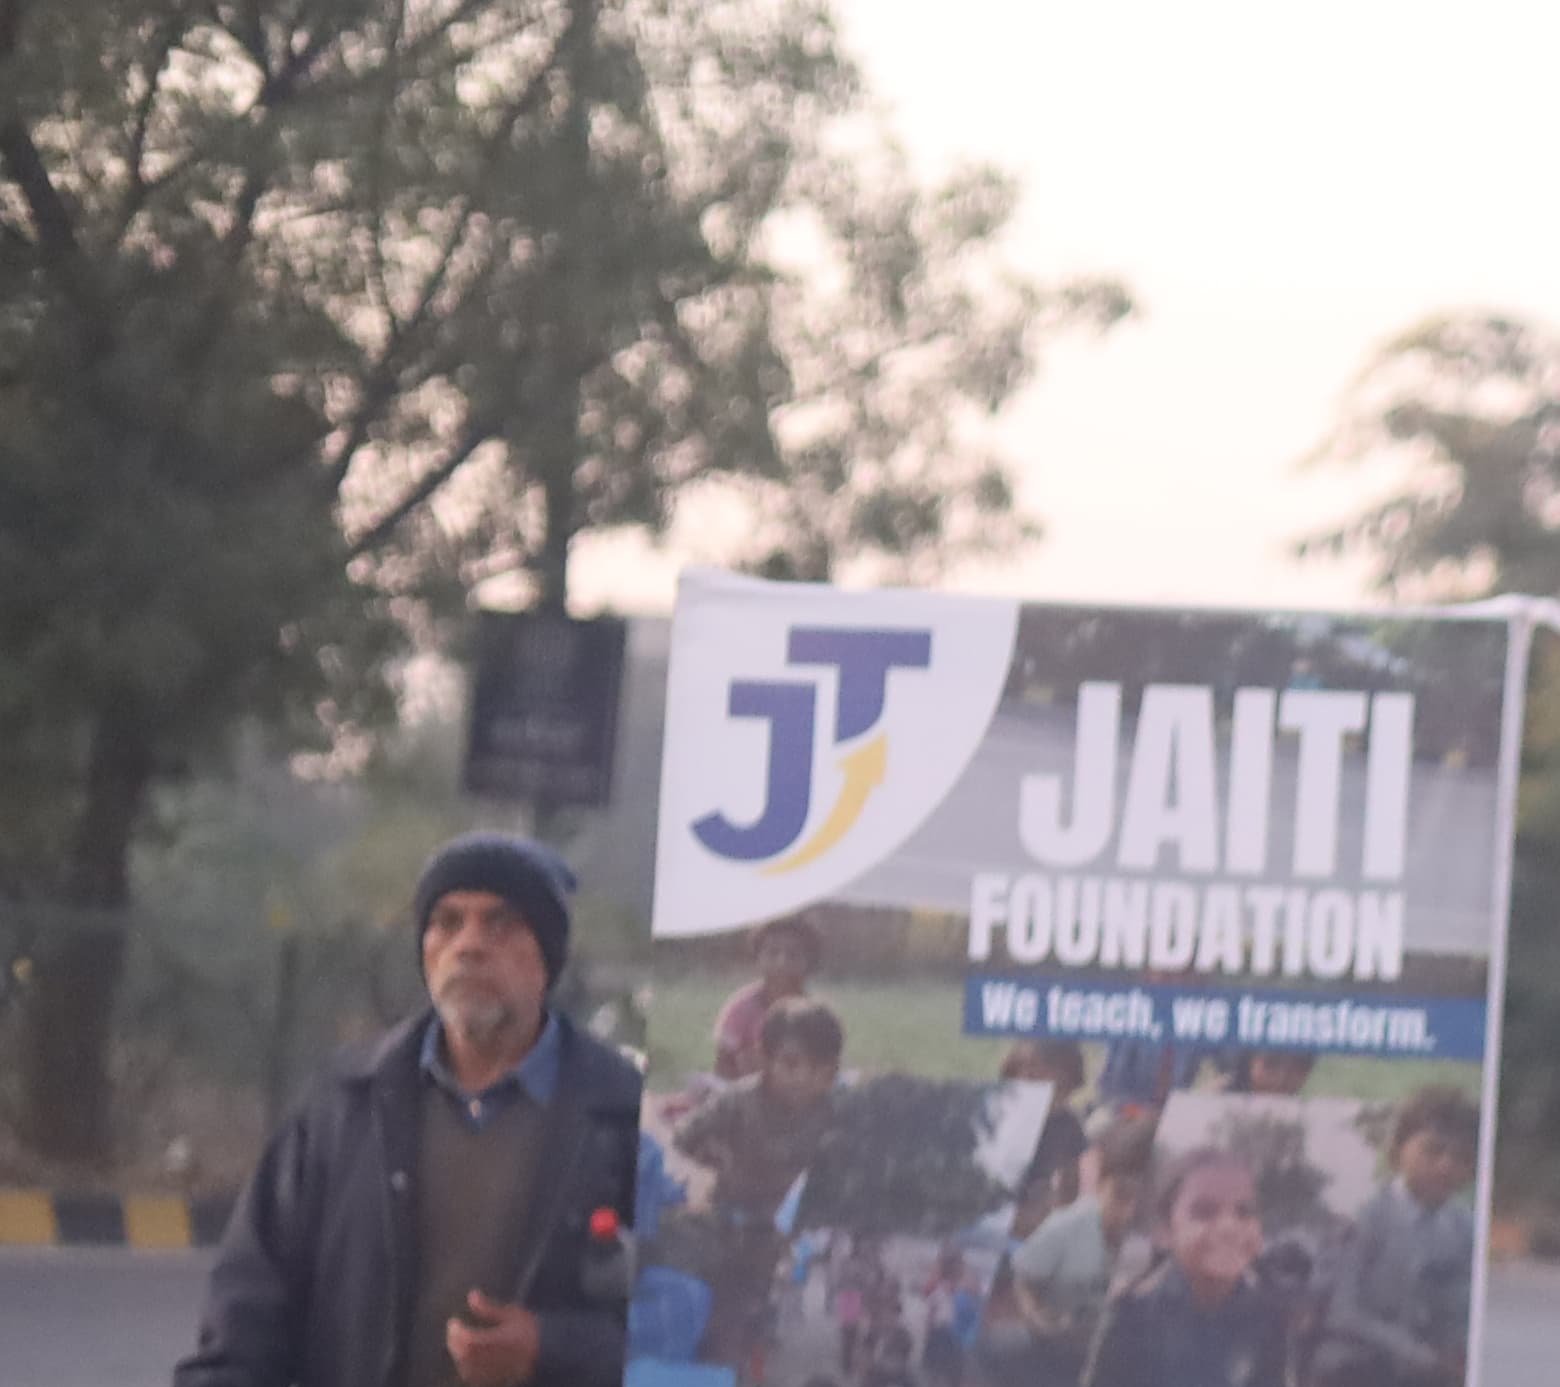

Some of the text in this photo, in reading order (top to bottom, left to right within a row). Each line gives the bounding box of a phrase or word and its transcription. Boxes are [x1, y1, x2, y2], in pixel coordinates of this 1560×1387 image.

[1017, 680, 1416, 880] JAITI
[966, 873, 1404, 980] FOUNDATION
[981, 981, 1437, 1050] We teach, we transform.
